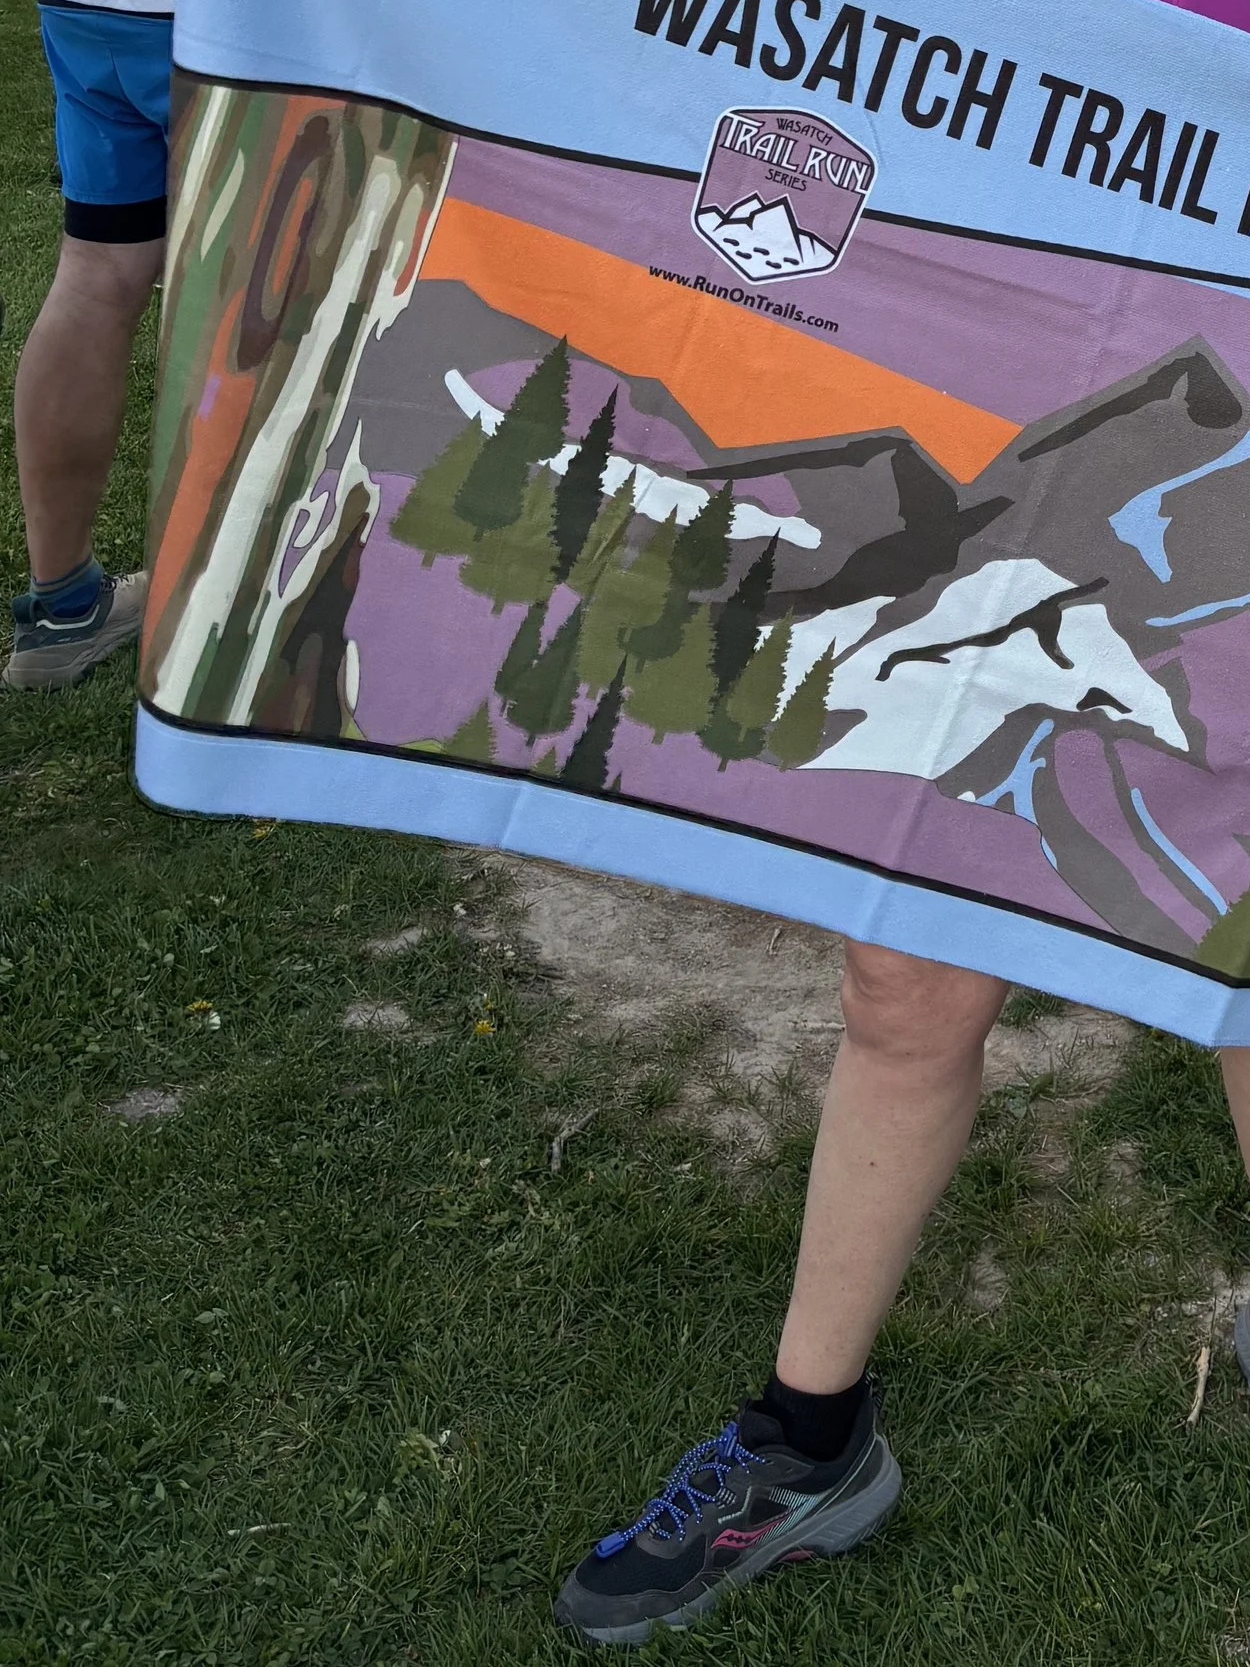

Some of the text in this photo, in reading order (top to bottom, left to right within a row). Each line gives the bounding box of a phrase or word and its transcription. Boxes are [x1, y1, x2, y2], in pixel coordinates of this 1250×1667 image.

[720, 112, 870, 195] TRAIL RUN
[776, 118, 833, 146] WASATCH
[1028, 72, 1220, 225] TRAIL
[765, 168, 807, 192] SERIES
[649, 265, 839, 333] www.RunOnTrails.com
